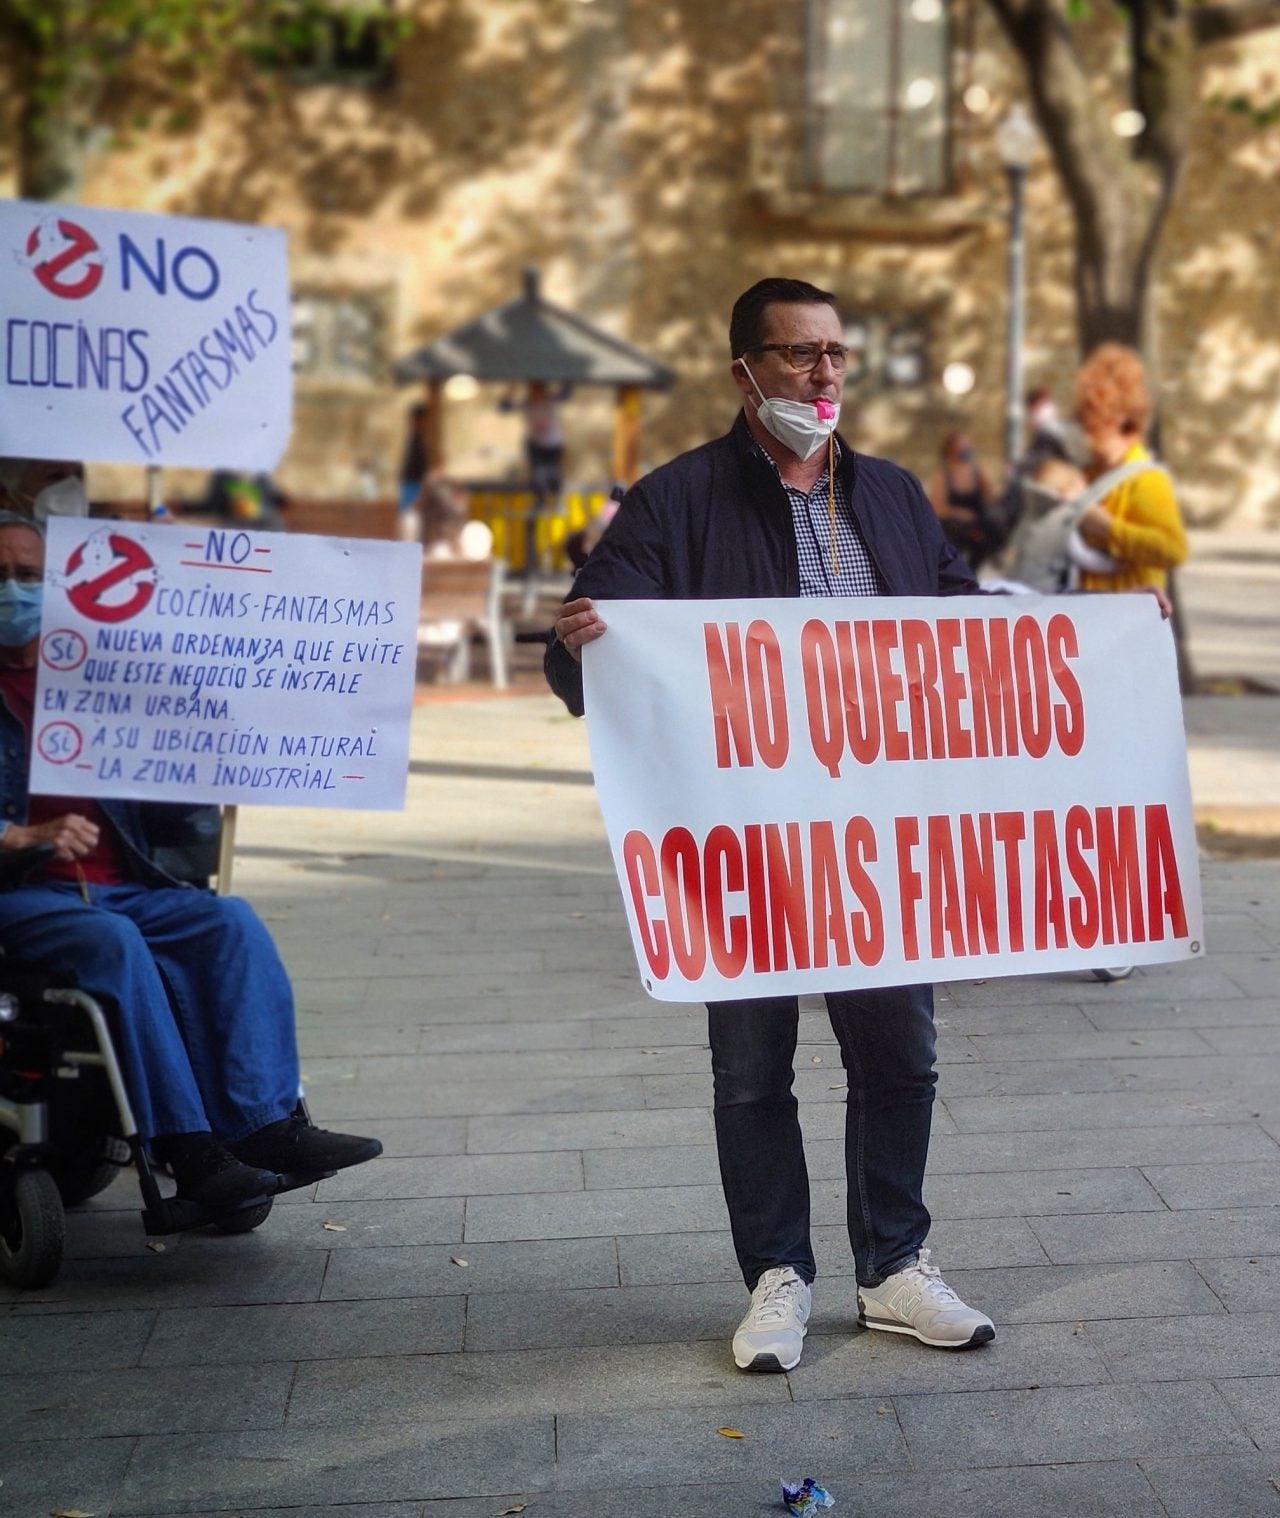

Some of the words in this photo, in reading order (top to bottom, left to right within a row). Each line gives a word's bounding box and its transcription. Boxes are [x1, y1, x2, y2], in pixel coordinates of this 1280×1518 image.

[119, 233, 220, 301] NO
[7, 318, 149, 393] COCINAS
[121, 288, 277, 457] FANTASMAS
[97, 628, 163, 653] NUEVA
[171, 632, 284, 665] ORDENANZA
[294, 640, 335, 665] QUE
[343, 637, 404, 665] EVITE
[43, 688, 69, 713] EN
[74, 690, 132, 715] ZONA
[83, 659, 120, 684] QUE
[123, 660, 167, 684] ESTE
[252, 667, 277, 688] SE
[281, 663, 362, 694] INSTALE
[704, 618, 790, 770] NO
[801, 613, 1085, 779] QUEREMOS
[91, 725, 107, 748] A
[113, 726, 140, 749] SU
[153, 725, 268, 756] UBICACIÓN
[279, 735, 377, 757] NATURAL
[98, 756, 122, 781] LA
[132, 759, 196, 785] ZONA
[211, 757, 336, 790] INDUSTRIAL
[623, 815, 885, 983] COCINAS
[895, 803, 1189, 962] FANTASMA
